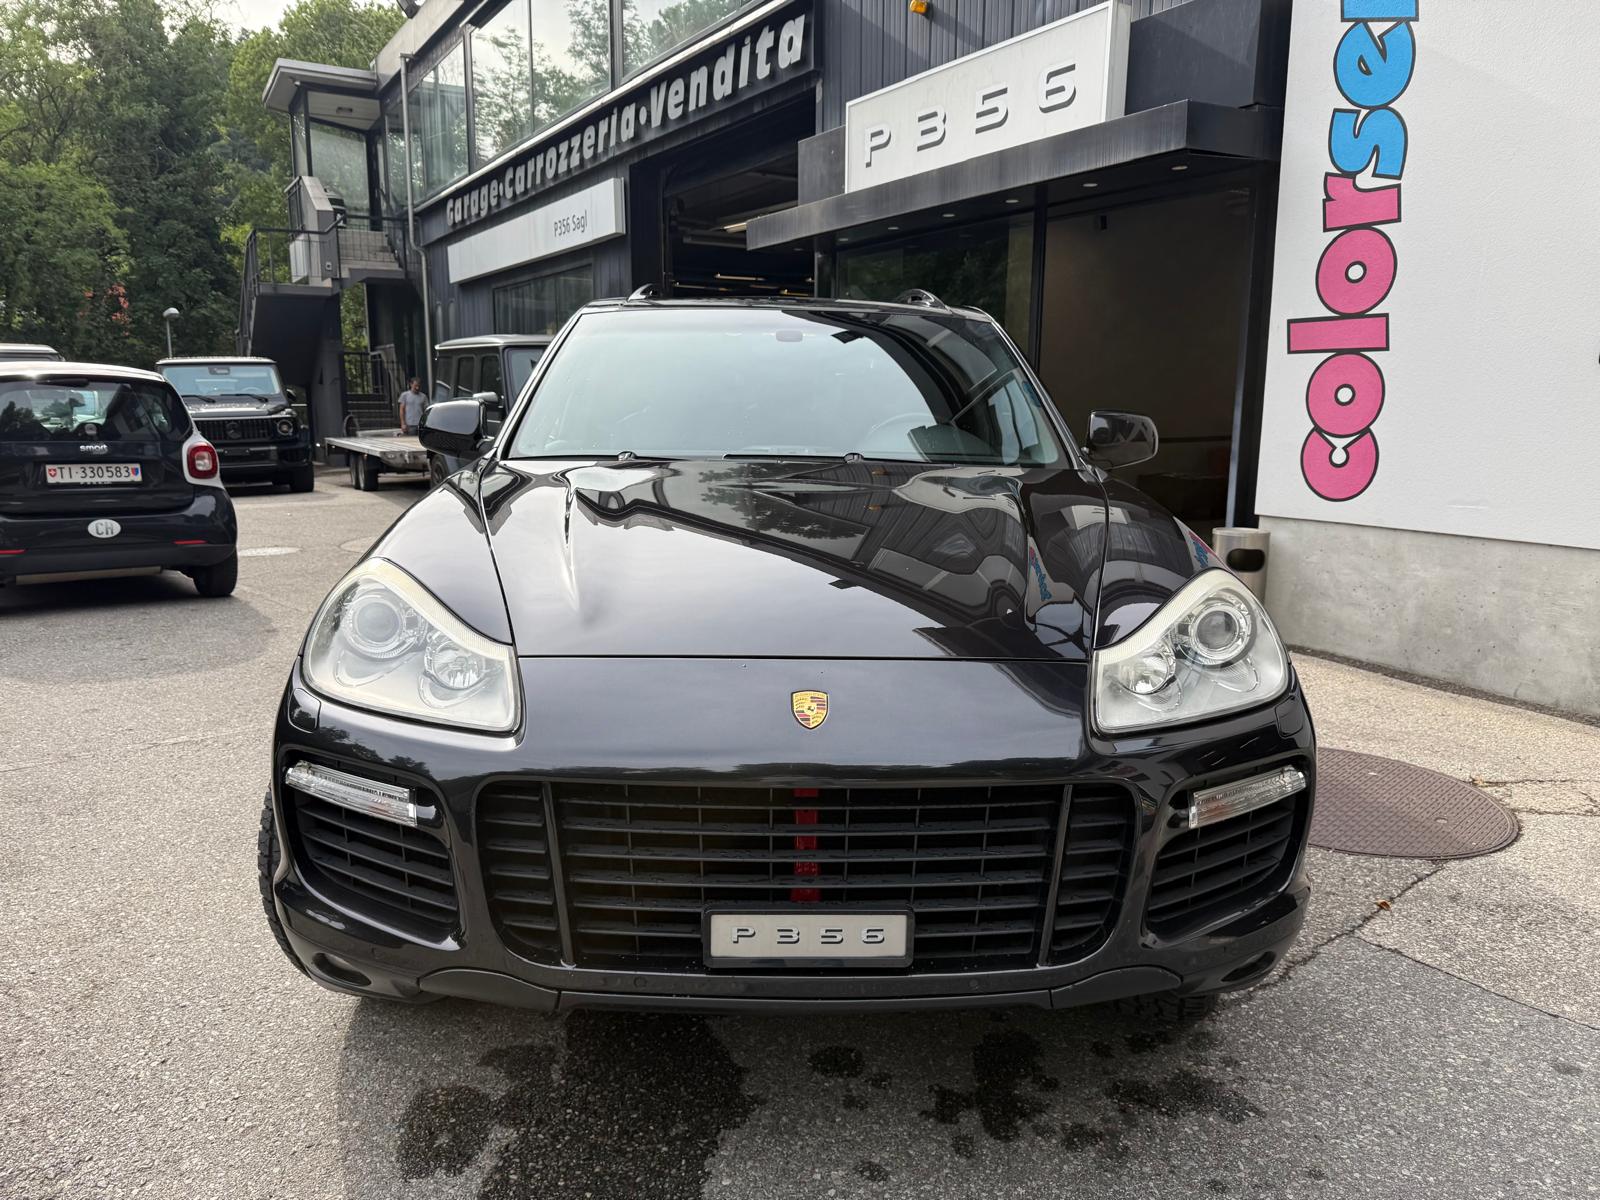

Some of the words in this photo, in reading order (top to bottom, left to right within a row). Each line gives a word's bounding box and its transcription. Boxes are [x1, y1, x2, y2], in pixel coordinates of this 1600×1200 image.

[446, 178, 499, 226] Garage
[504, 102, 636, 199] Carrozzeria
[650, 14, 805, 129] Vendita
[863, 62, 1077, 168] P356
[553, 216, 571, 237] P356
[1287, 0, 1420, 502] colorse
[79, 444, 108, 452] smart
[95, 522, 114, 536] CH
[731, 926, 885, 945] P356
